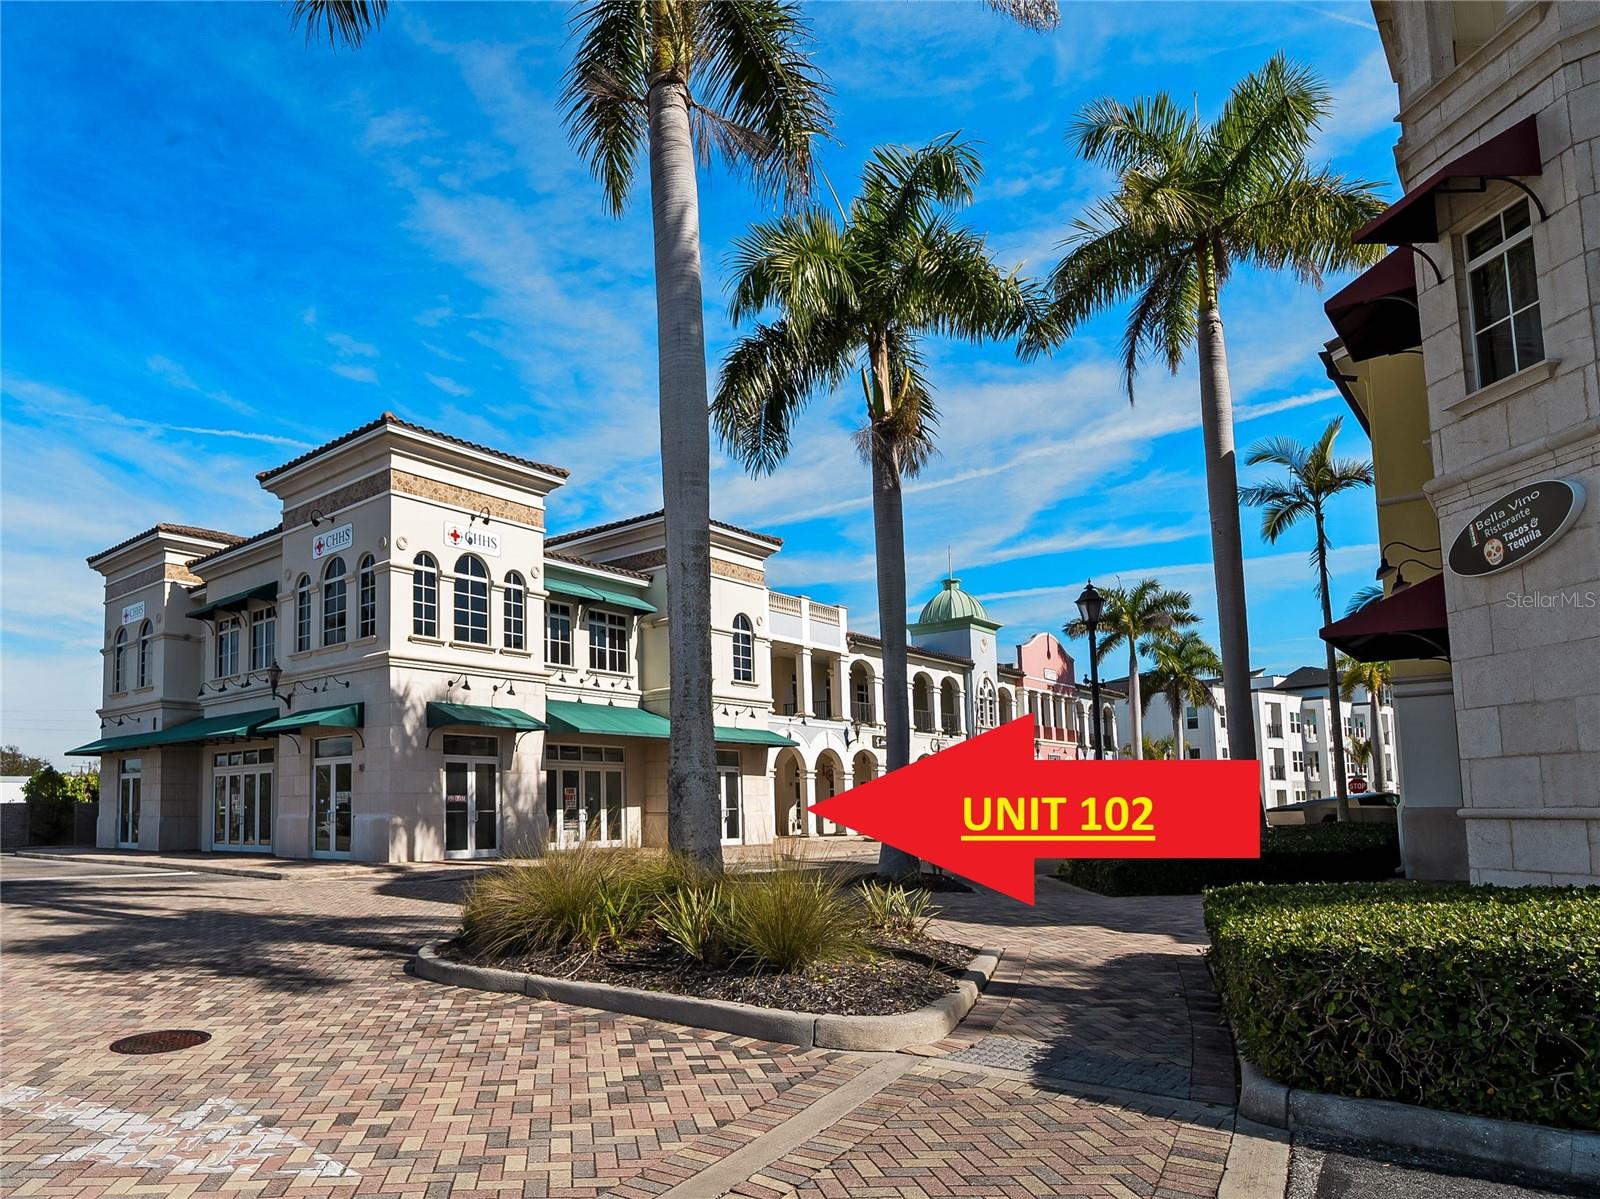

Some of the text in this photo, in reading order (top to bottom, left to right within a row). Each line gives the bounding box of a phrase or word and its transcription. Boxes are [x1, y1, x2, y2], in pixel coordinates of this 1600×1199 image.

[1476, 490, 1540, 531] Bella Vino
[1484, 508, 1531, 537] Ristorante
[1503, 517, 1539, 542] Tacos &
[326, 528, 351, 549] CHHS
[465, 531, 497, 549] CHHS
[1507, 529, 1542, 551] Tequila
[1349, 782, 1366, 790] STOP
